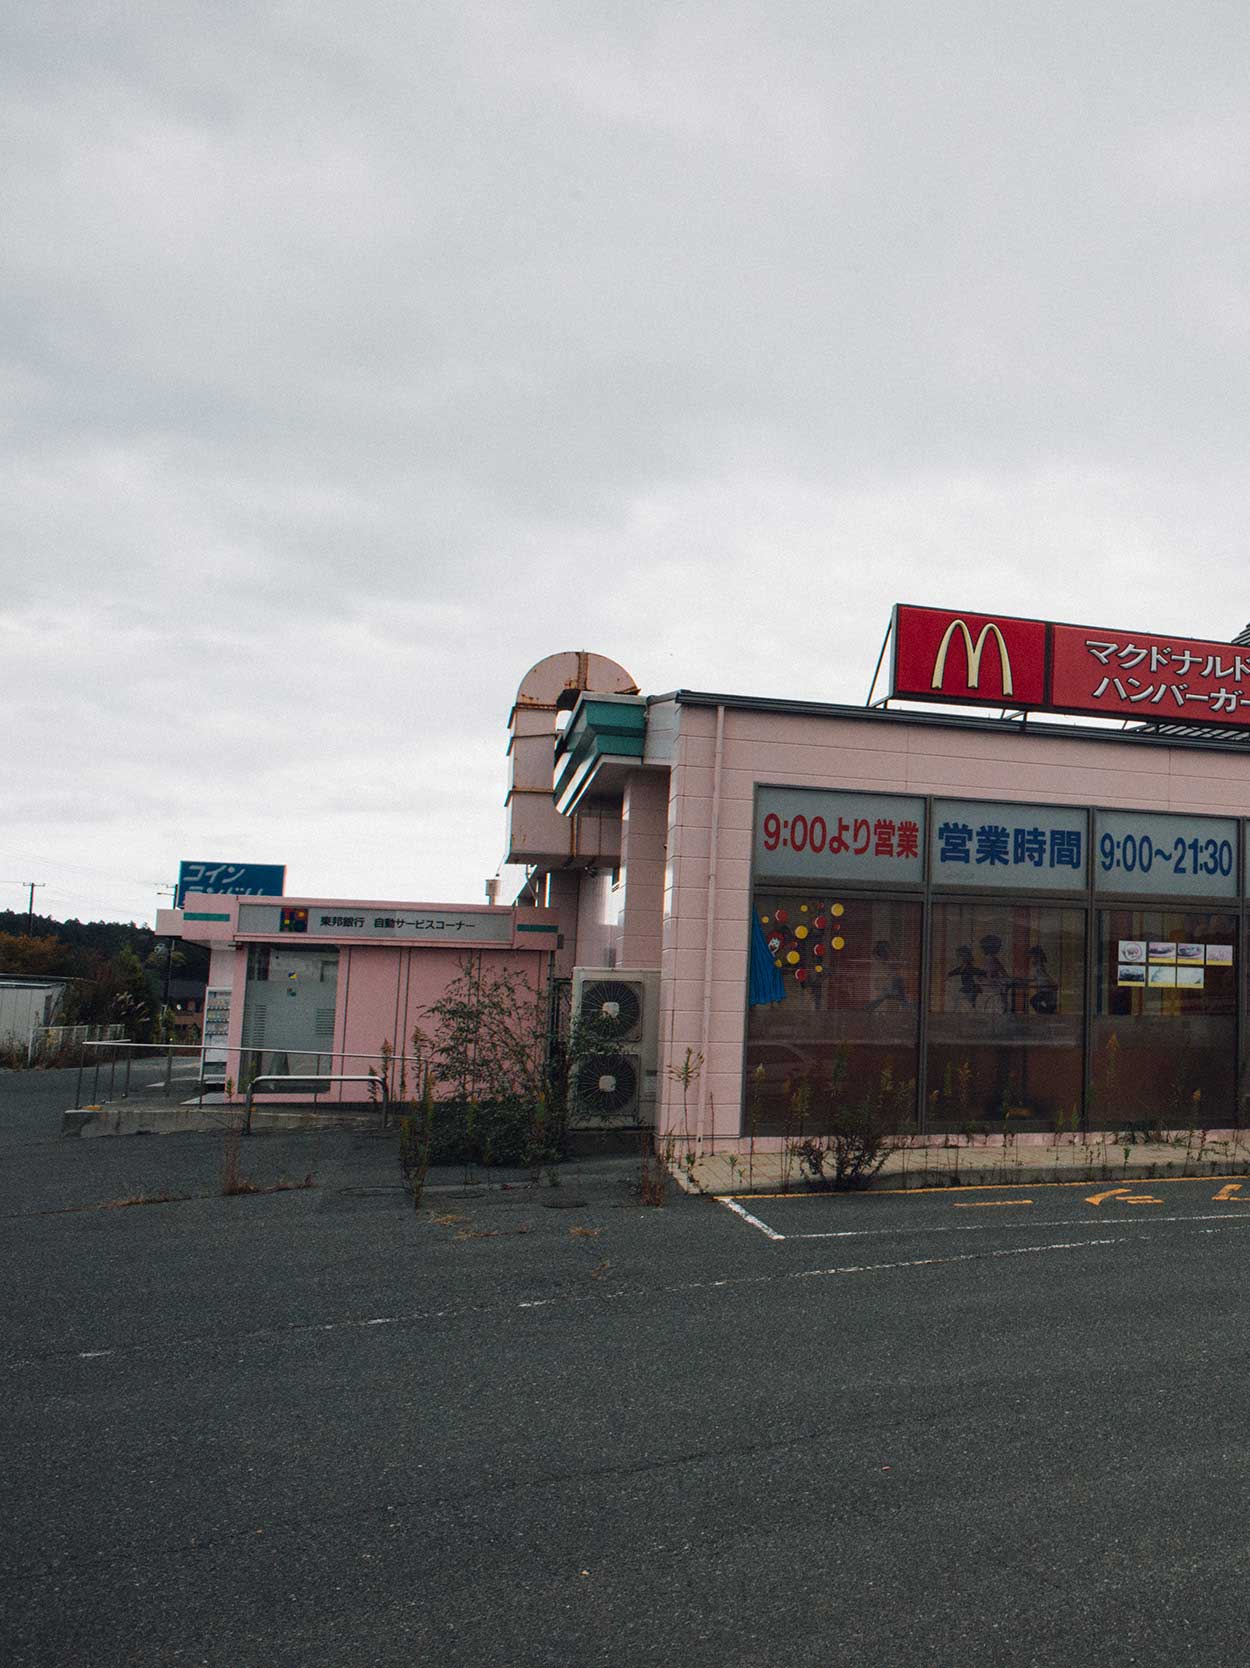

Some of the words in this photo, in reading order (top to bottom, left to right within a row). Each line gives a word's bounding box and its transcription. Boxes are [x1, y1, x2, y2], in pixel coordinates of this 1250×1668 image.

[763, 813, 920, 859] 9:00より営業
[938, 822, 1082, 869] 営業時間
[183, 864, 247, 885] コイン
